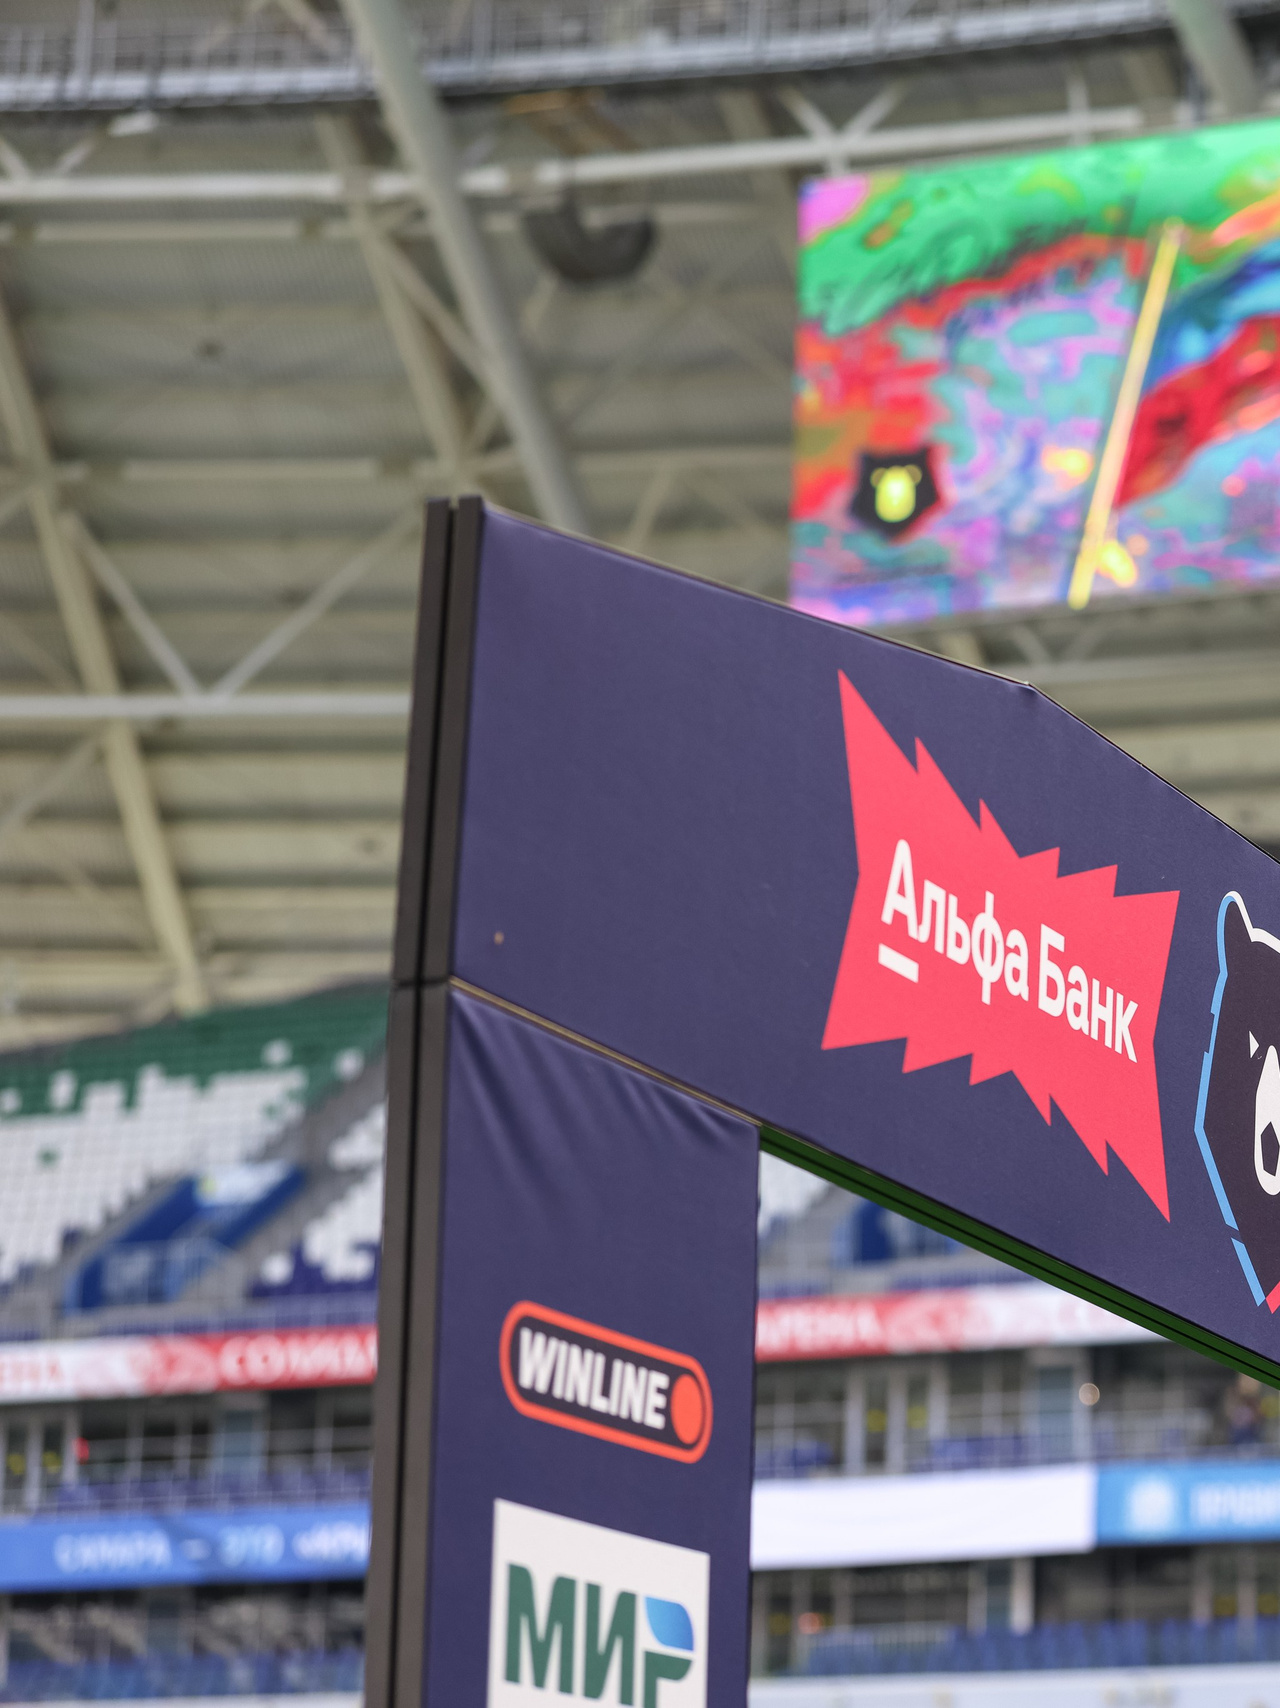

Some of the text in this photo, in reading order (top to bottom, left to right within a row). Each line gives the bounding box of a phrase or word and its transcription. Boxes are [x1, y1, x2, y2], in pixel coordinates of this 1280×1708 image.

[880, 838, 1139, 1063] Альфа Банк
[518, 1327, 671, 1430] WINLINE
[505, 1562, 694, 1708] МИР
